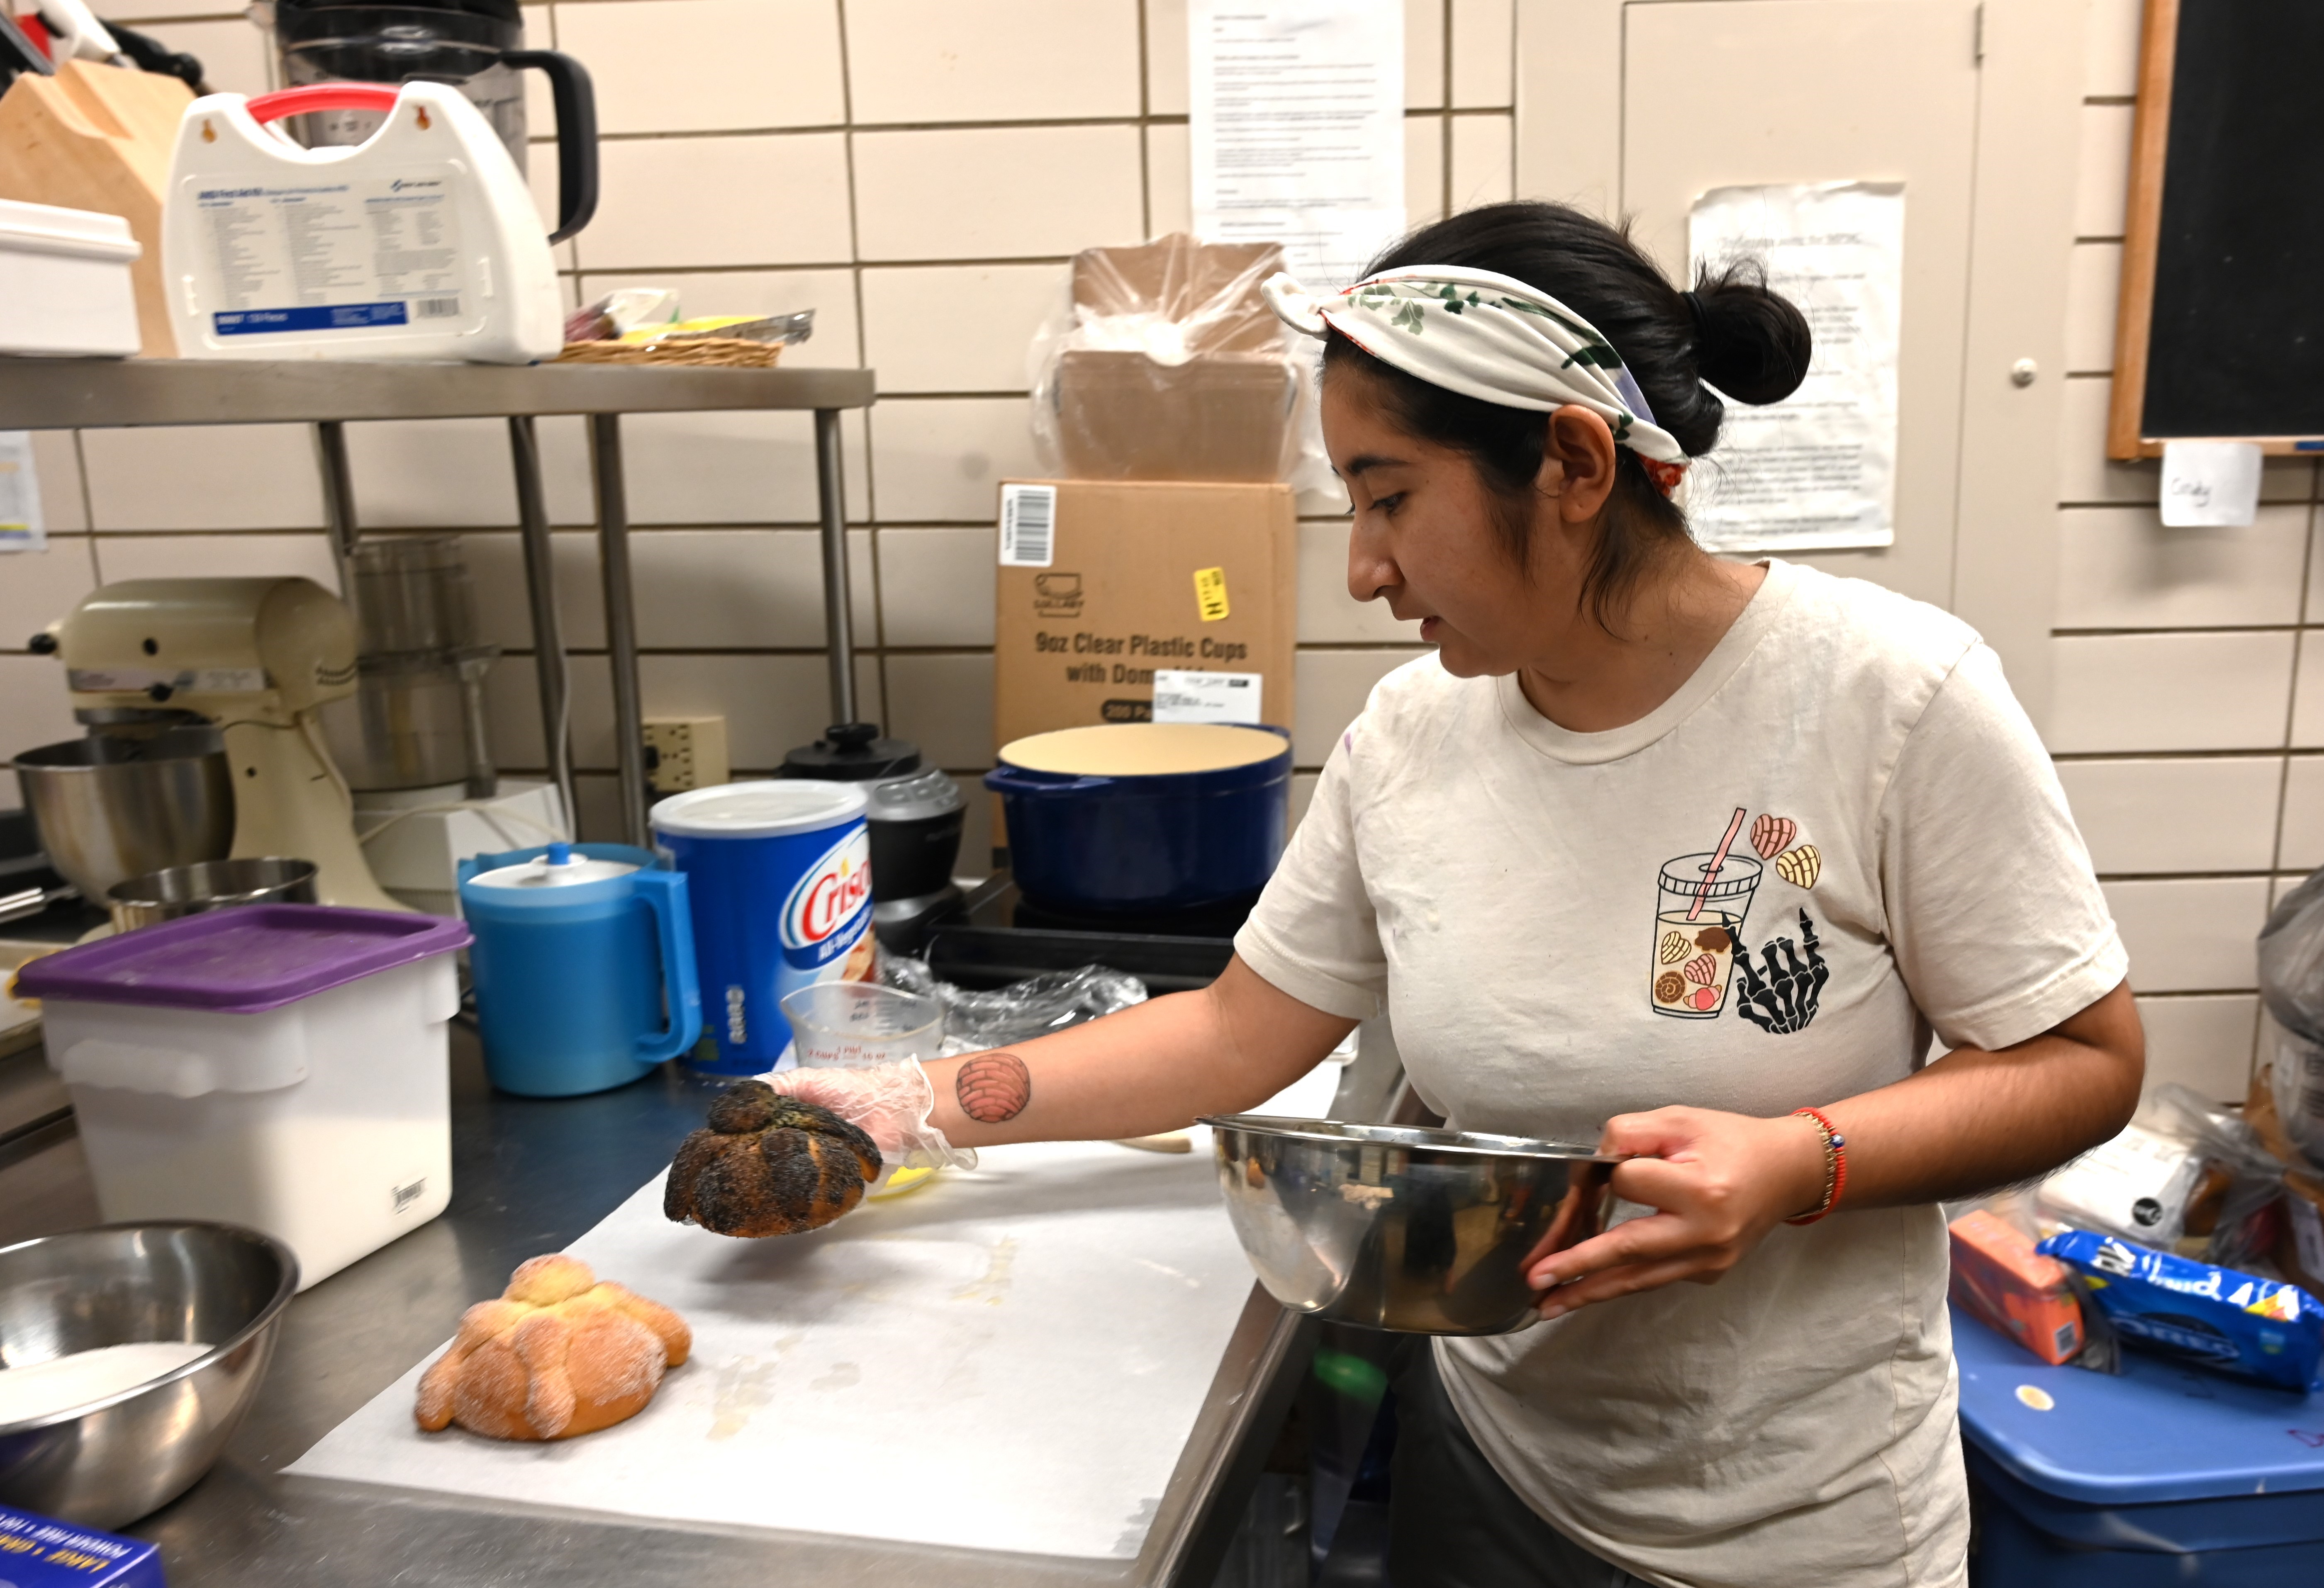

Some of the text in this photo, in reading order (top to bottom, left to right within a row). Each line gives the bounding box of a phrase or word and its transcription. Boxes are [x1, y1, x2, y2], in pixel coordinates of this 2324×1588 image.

[1036, 632, 1248, 663] 9oz Clear Plastic Cups
[1067, 664, 1106, 683] with
[1113, 664, 1155, 684] Dom
